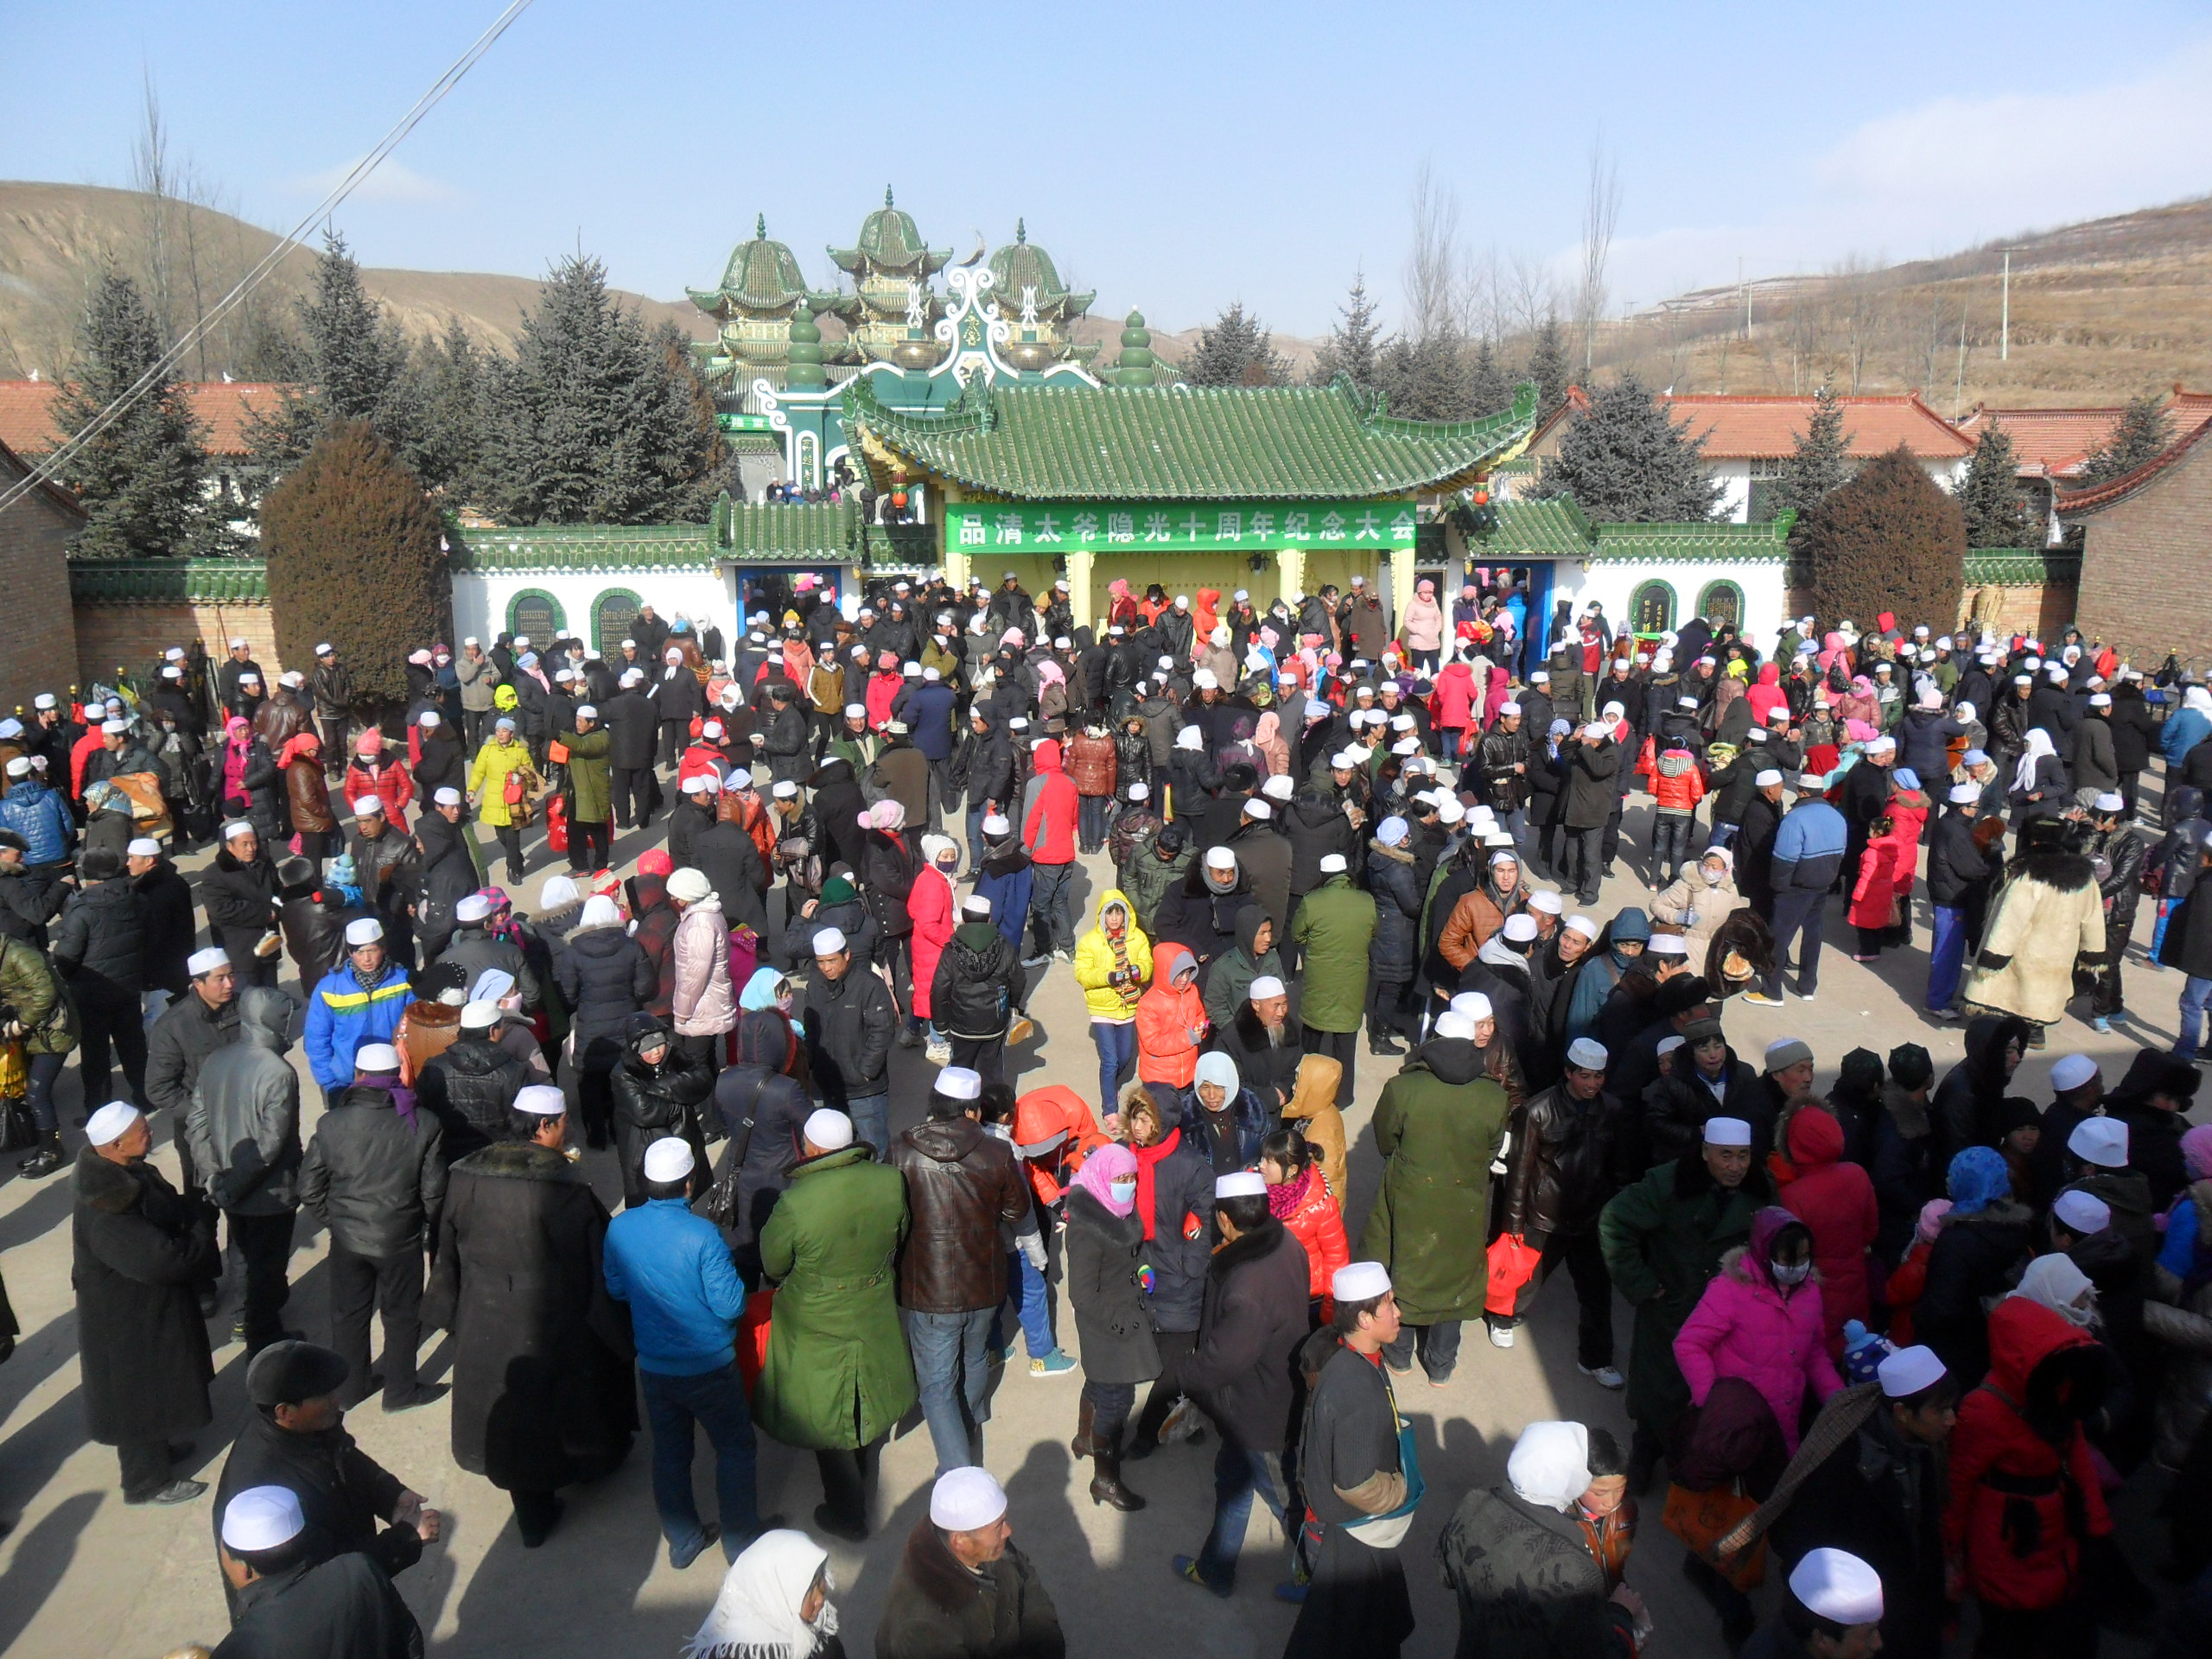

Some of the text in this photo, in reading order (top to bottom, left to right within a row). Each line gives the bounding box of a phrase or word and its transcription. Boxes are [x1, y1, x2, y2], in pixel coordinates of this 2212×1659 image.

[960, 511, 1414, 544] 品清太爷隐光十周年纪念大会
